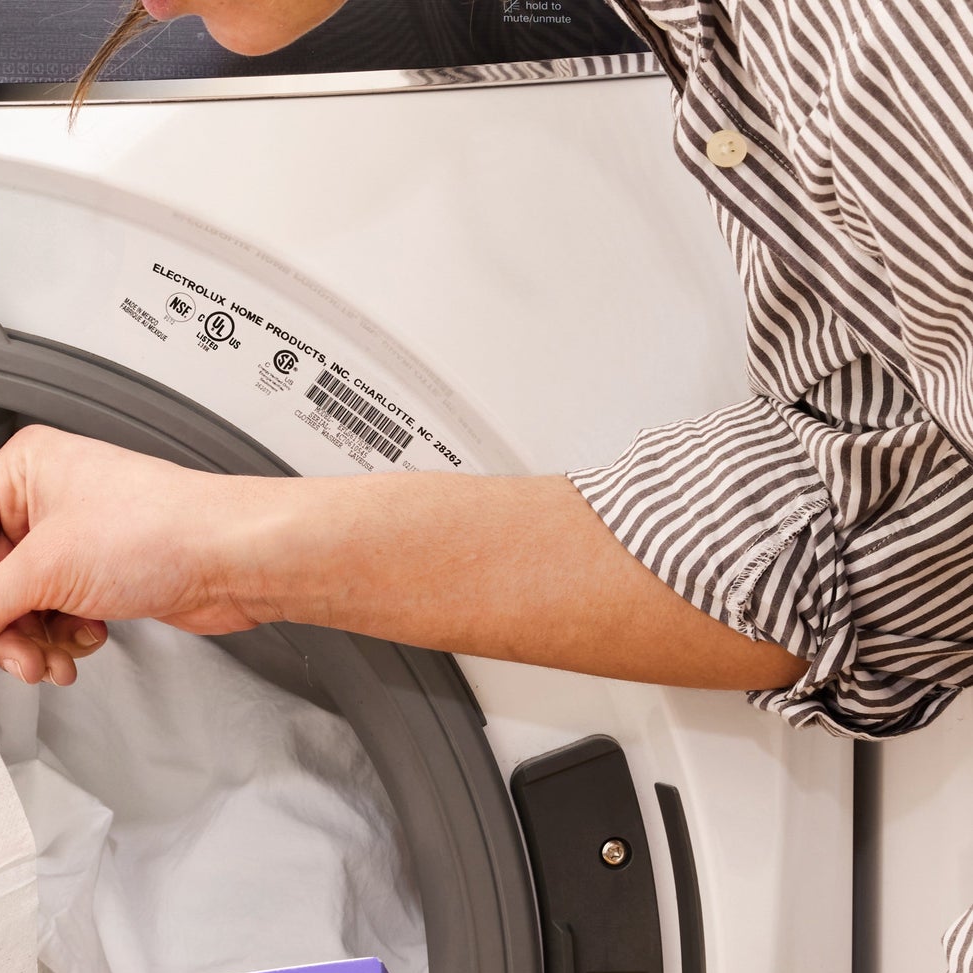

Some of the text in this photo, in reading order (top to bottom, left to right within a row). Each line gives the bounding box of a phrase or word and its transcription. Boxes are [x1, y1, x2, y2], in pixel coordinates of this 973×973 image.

[525, 1, 562, 11] hold to
[503, 14, 572, 24] mute/unmute
[197, 313, 206, 323] C
[211, 315, 225, 338] UL
[196, 331, 219, 351] LISTED
[228, 337, 242, 350] US
[152, 263, 226, 306] ELECTROLUX
[230, 302, 264, 326] HOME
[265, 322, 327, 367] PRODUCTS,
[330, 362, 350, 382] INC.
[353, 378, 415, 430] CHARLOTTE,
[417, 426, 433, 441] NC
[433, 440, 462, 467] 28262
